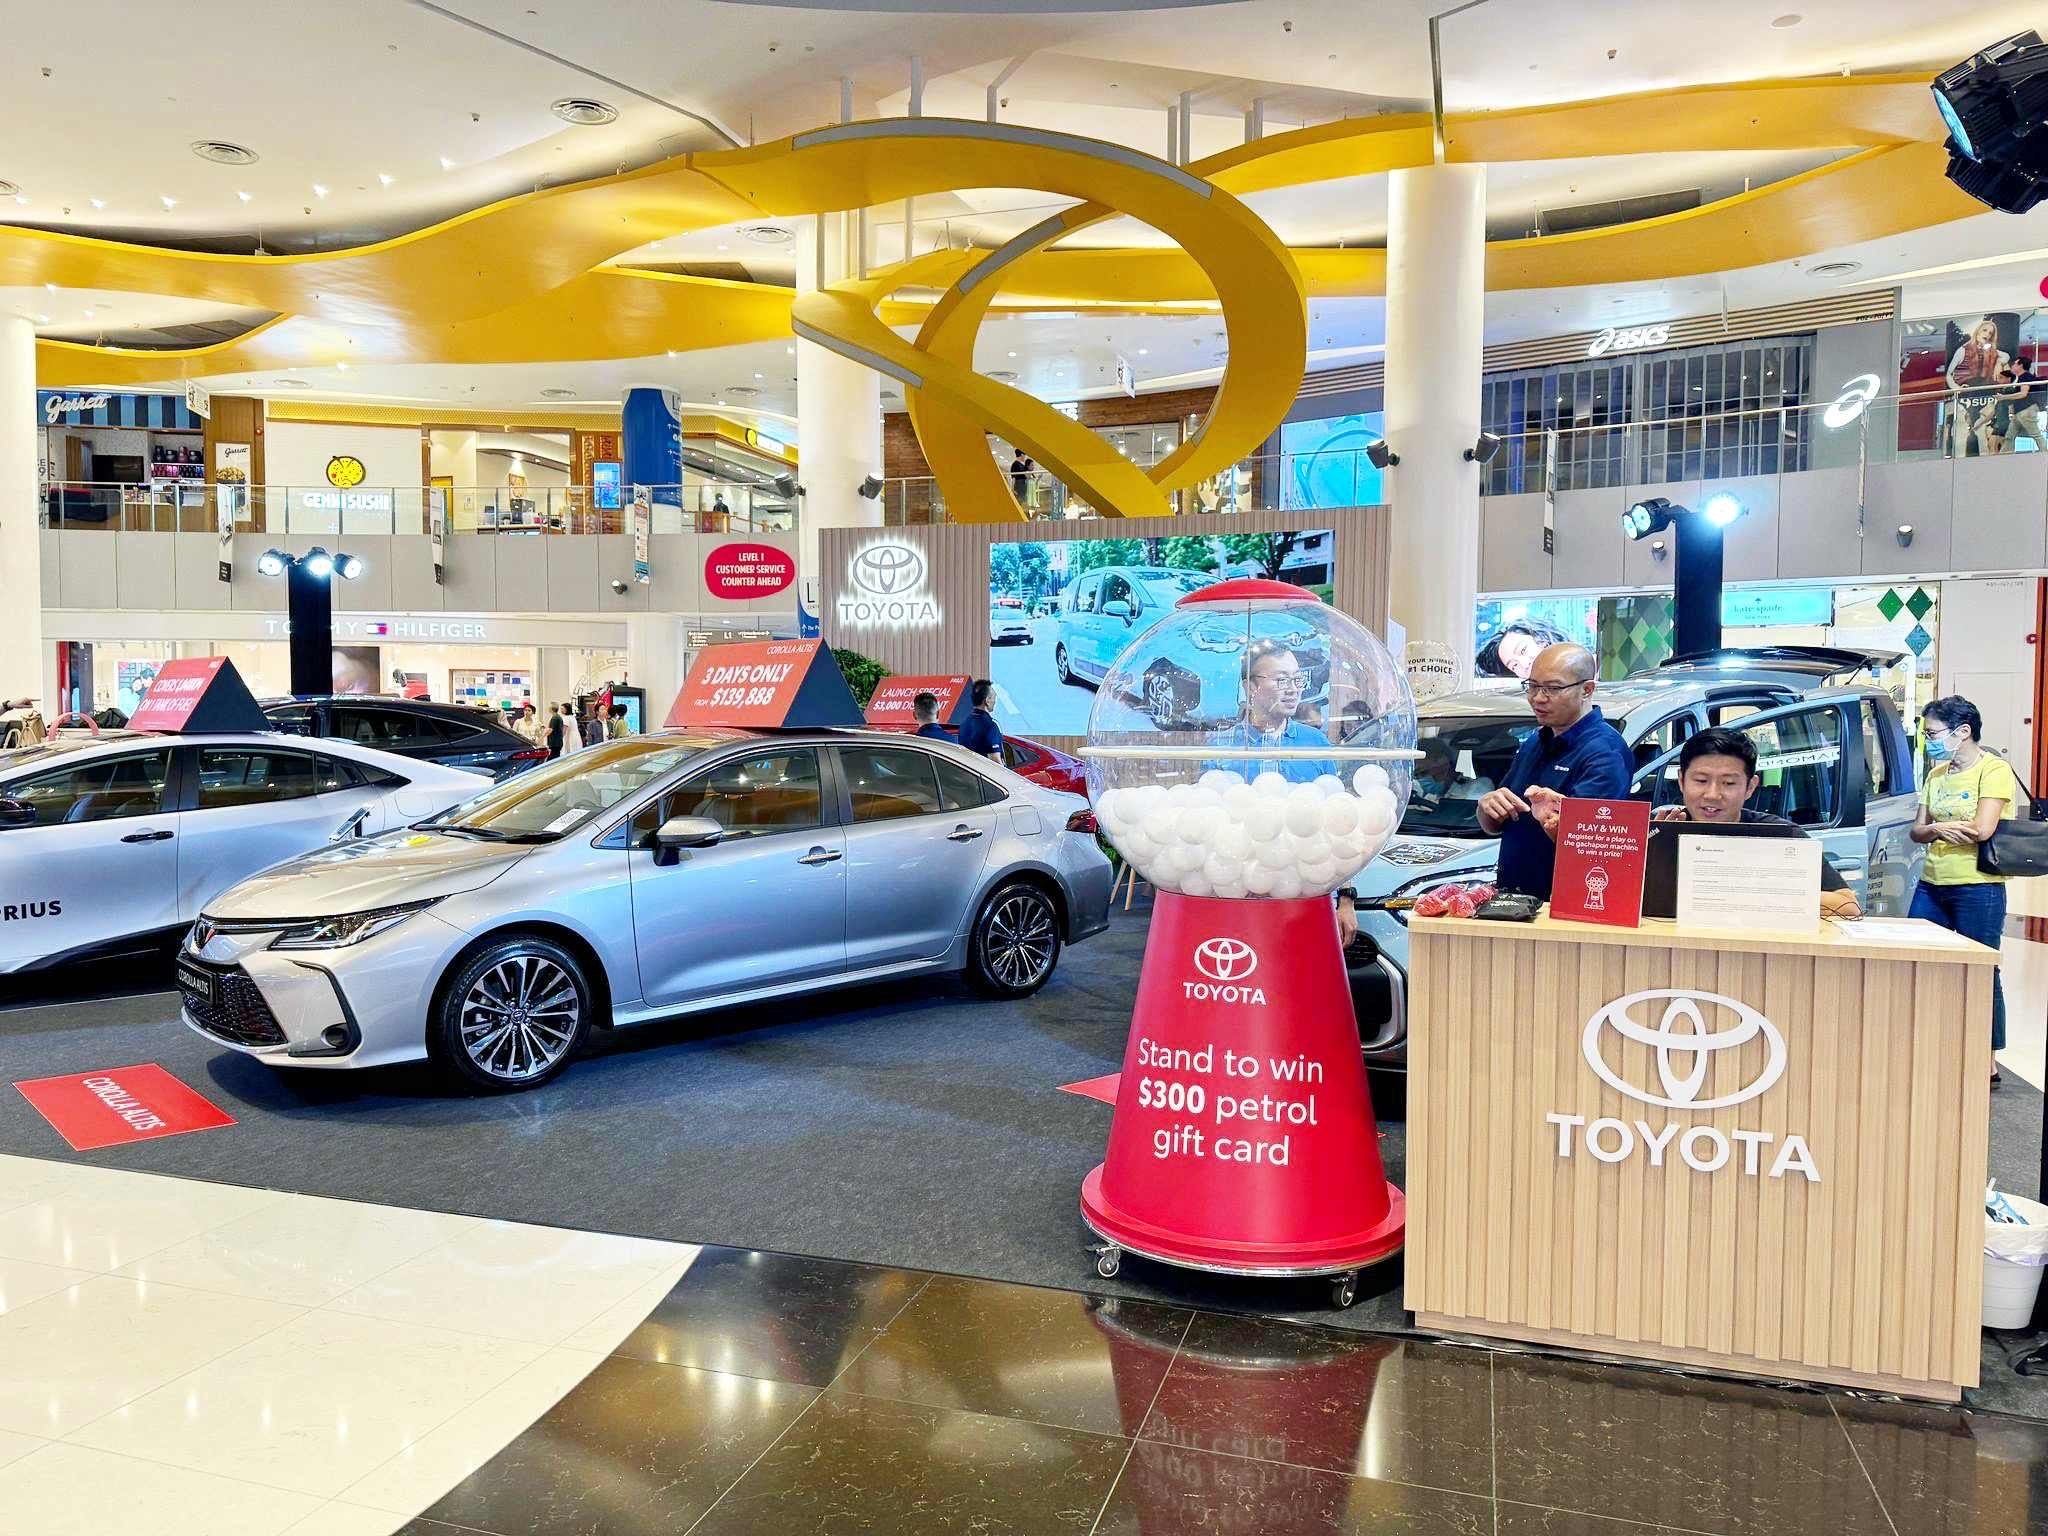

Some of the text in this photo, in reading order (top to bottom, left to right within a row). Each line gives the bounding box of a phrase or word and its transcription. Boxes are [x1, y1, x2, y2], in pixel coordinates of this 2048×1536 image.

[45, 394, 112, 423] Garrett
[347, 494, 390, 510] SUSHI
[738, 552, 759, 561] LEVEL
[715, 564, 786, 574] CUSTOMER SERVICE
[721, 576, 782, 586] COUNTER AHEAD
[839, 602, 935, 620] TOYOTA
[265, 620, 486, 639] TOY HILFIGER
[767, 643, 815, 655] COROLLA ALTIS
[702, 663, 794, 684] 3 DAYS ONLY
[1420, 666, 1453, 674] CHOICE
[709, 686, 776, 708] $139,888
[881, 687, 917, 697] LAUNCH
[902, 700, 949, 710] DISNT
[1567, 832, 1594, 841] Register
[1577, 823, 1628, 833] PLAY & WIN
[0, 900, 61, 921] RIUS
[1183, 981, 1267, 1006] TOYOTA
[1137, 1037, 1323, 1084] Stand to win
[82, 1077, 167, 1131] COROLLA ALTIS
[1138, 1076, 1318, 1126] $300 petrol
[1153, 1124, 1290, 1166] gift card
[1546, 1112, 1822, 1183] TOYOTA
